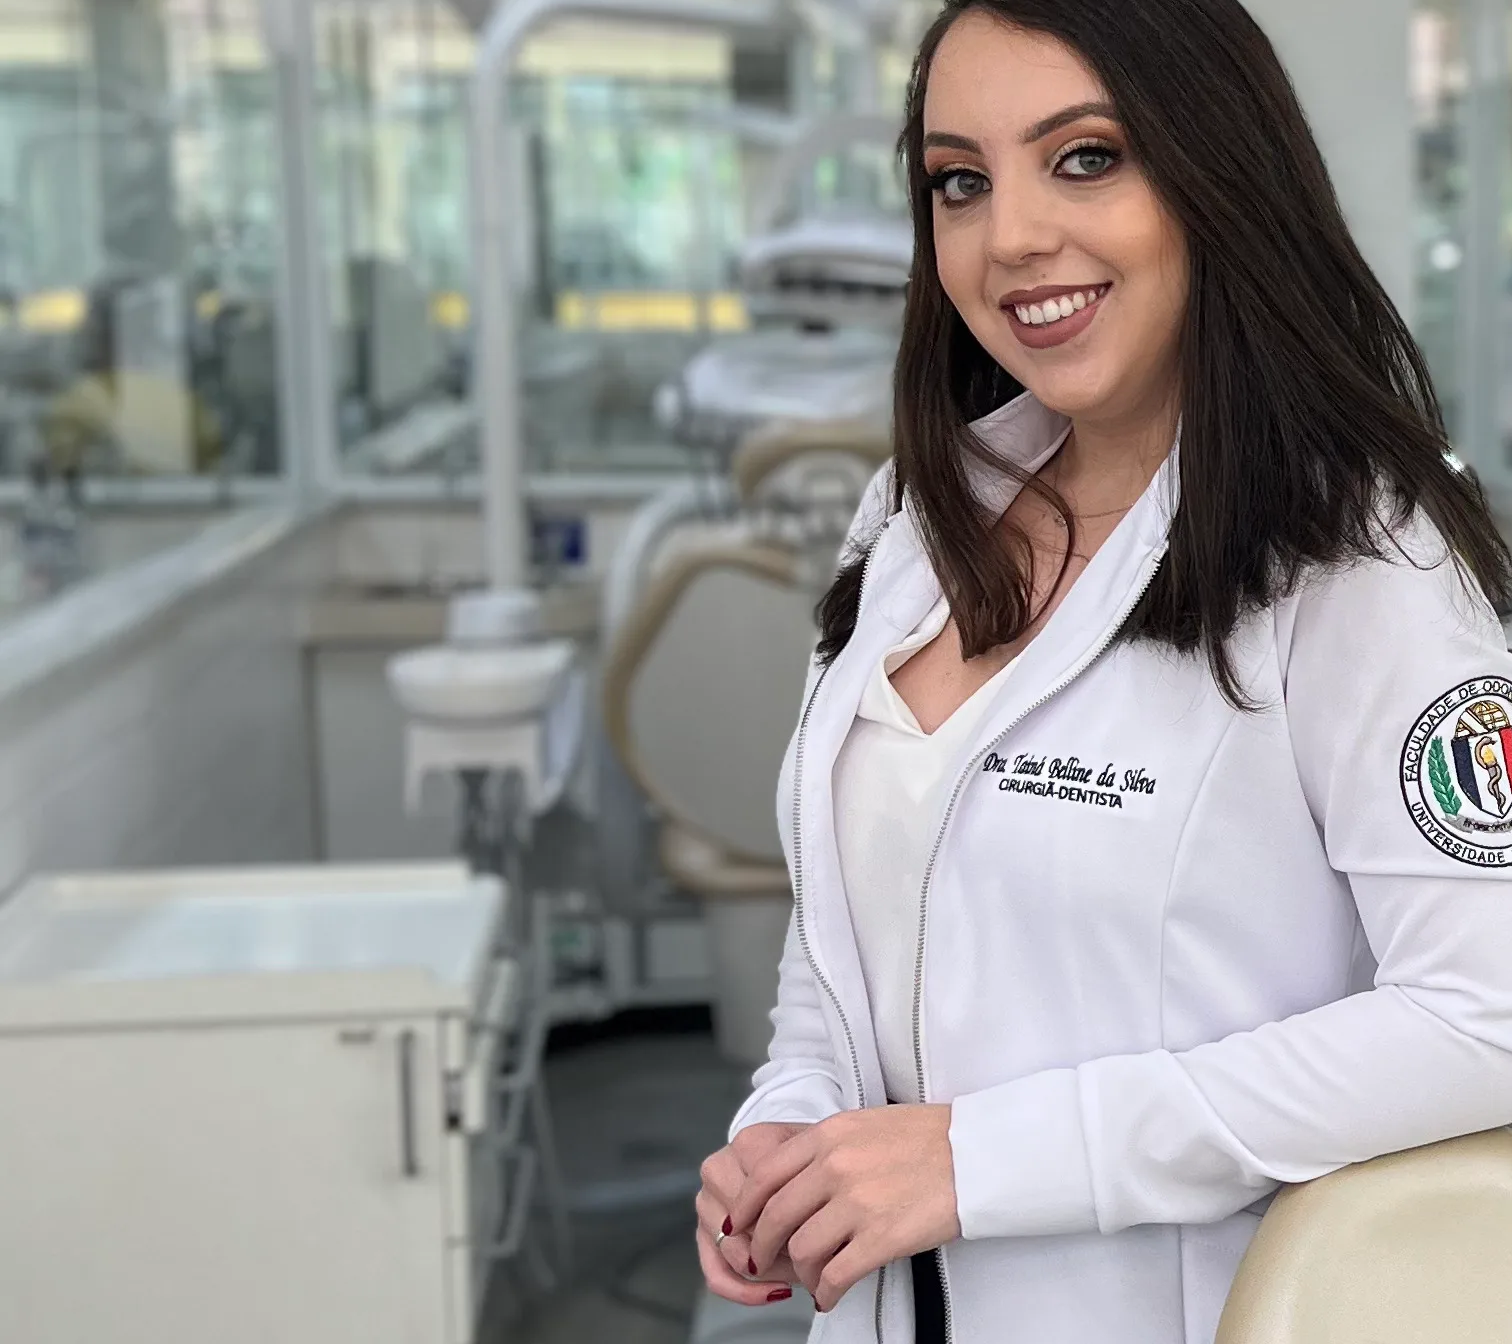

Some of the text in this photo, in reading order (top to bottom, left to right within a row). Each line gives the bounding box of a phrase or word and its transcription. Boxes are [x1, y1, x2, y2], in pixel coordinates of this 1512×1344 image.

[1405, 695, 1457, 782] FACULDADE
[1458, 683, 1479, 701] DE
[999, 778, 1122, 808] CIRURGIÃ-DENTISTA
[1096, 763, 1116, 787] da
[1119, 767, 1156, 795] Silva
[1411, 801, 1505, 863] UNIVERSIDADE
